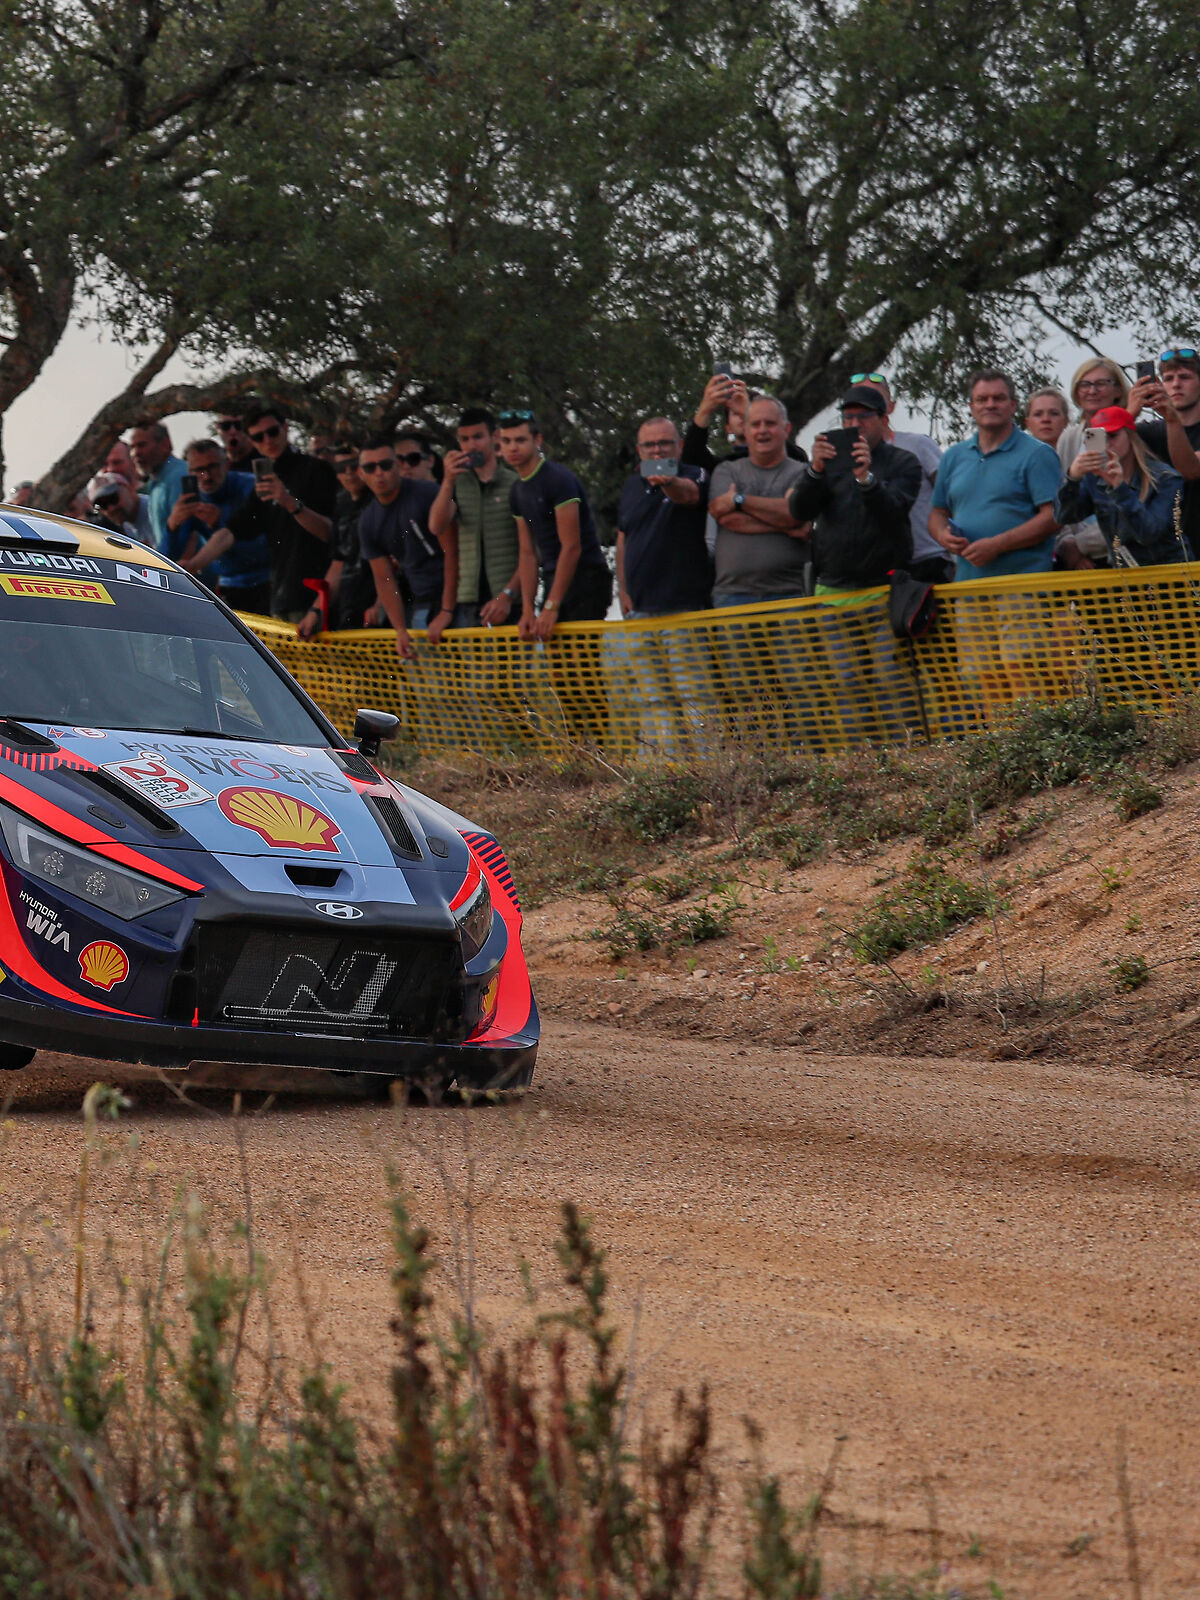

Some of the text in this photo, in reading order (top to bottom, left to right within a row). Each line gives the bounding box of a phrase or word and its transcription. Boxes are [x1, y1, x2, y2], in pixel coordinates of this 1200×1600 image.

[7, 577, 102, 600] PIRELLI
[120, 742, 259, 760] HYUNDAI
[178, 755, 352, 793] MOBIS
[140, 779, 175, 804] ITALIA
[150, 778, 187, 801] RALLY
[19, 890, 58, 921] HYUNDAI
[26, 909, 70, 952] WIA
